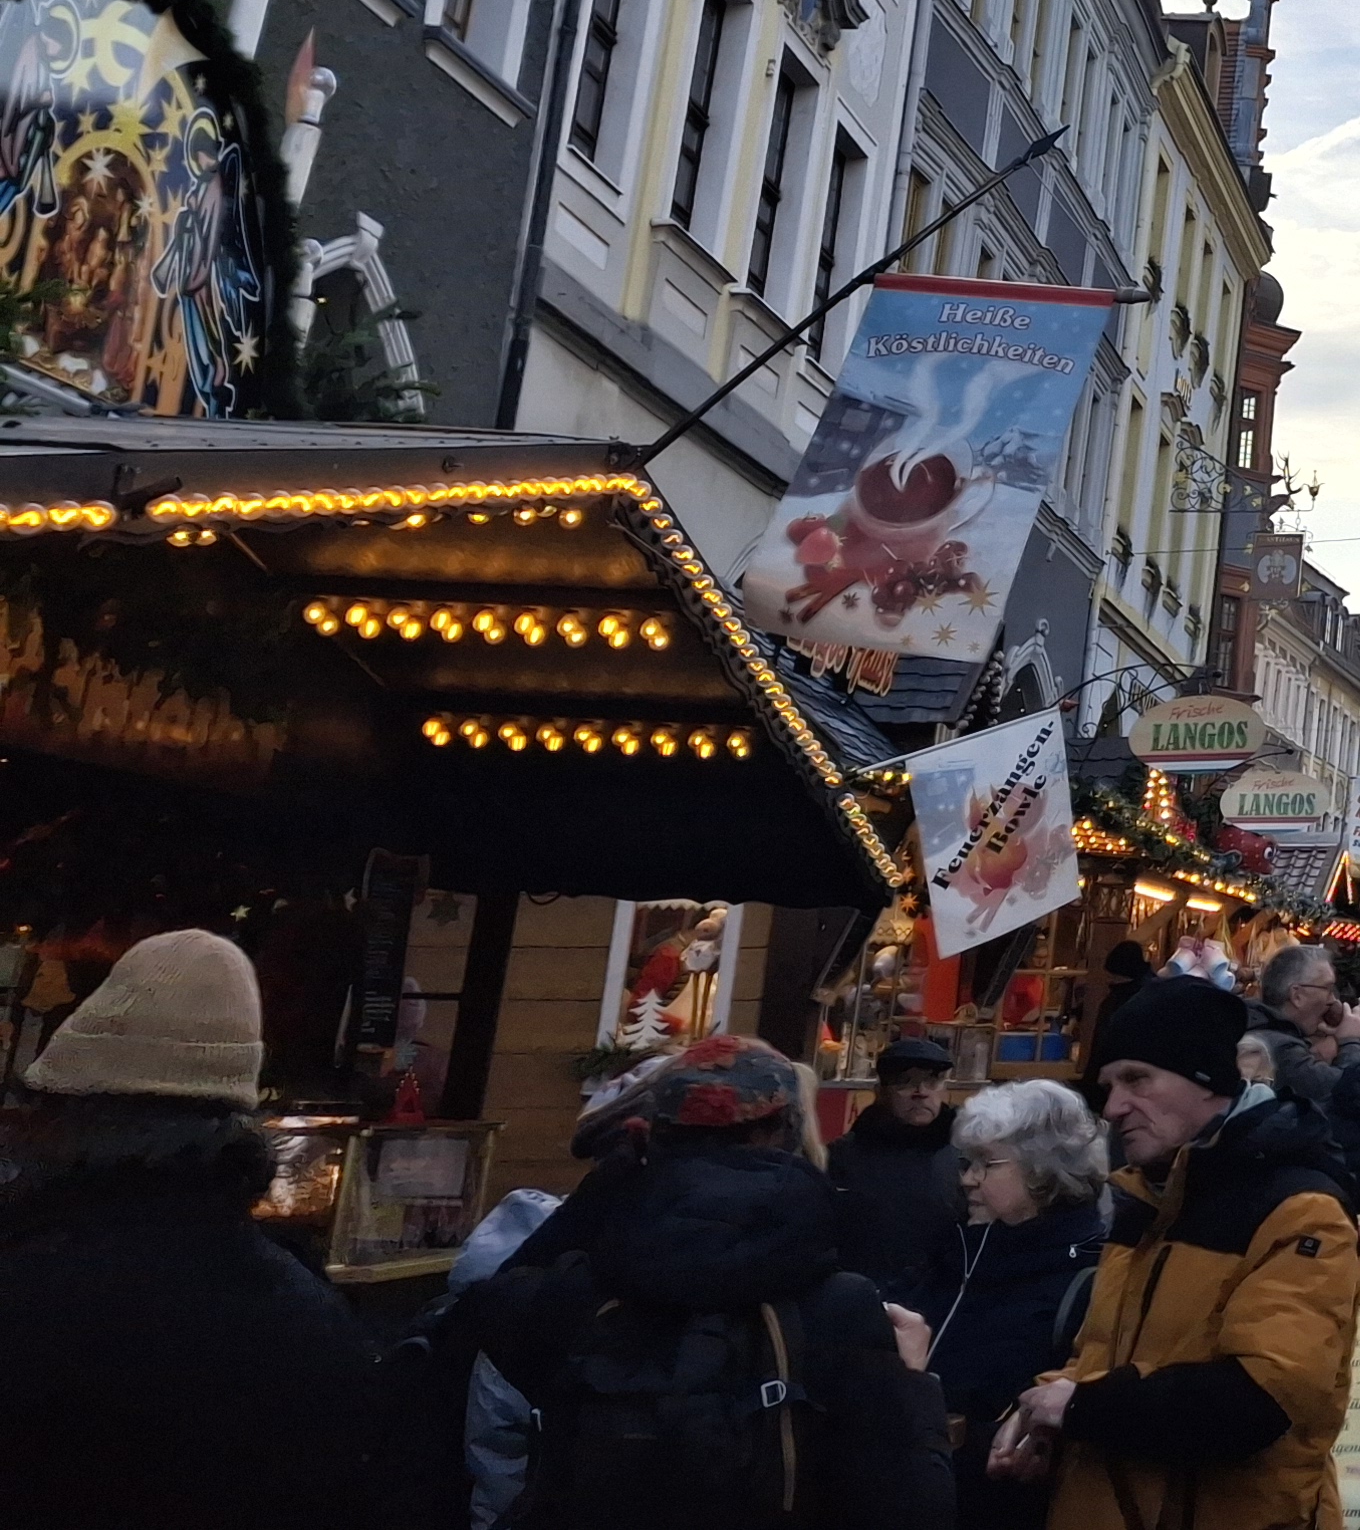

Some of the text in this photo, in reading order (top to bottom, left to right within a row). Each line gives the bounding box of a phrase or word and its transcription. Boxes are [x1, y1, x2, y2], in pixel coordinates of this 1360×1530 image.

[939, 302, 1032, 330] Heiße
[866, 330, 1075, 374] Köstlichkeiten
[1169, 702, 1225, 720] Frische
[1151, 721, 1248, 752] LANGOS
[1252, 777, 1296, 791] Frische
[932, 721, 1054, 890] Feuerzangen-
[985, 774, 1047, 855] Bowle
[1237, 792, 1317, 817] LANGOS
